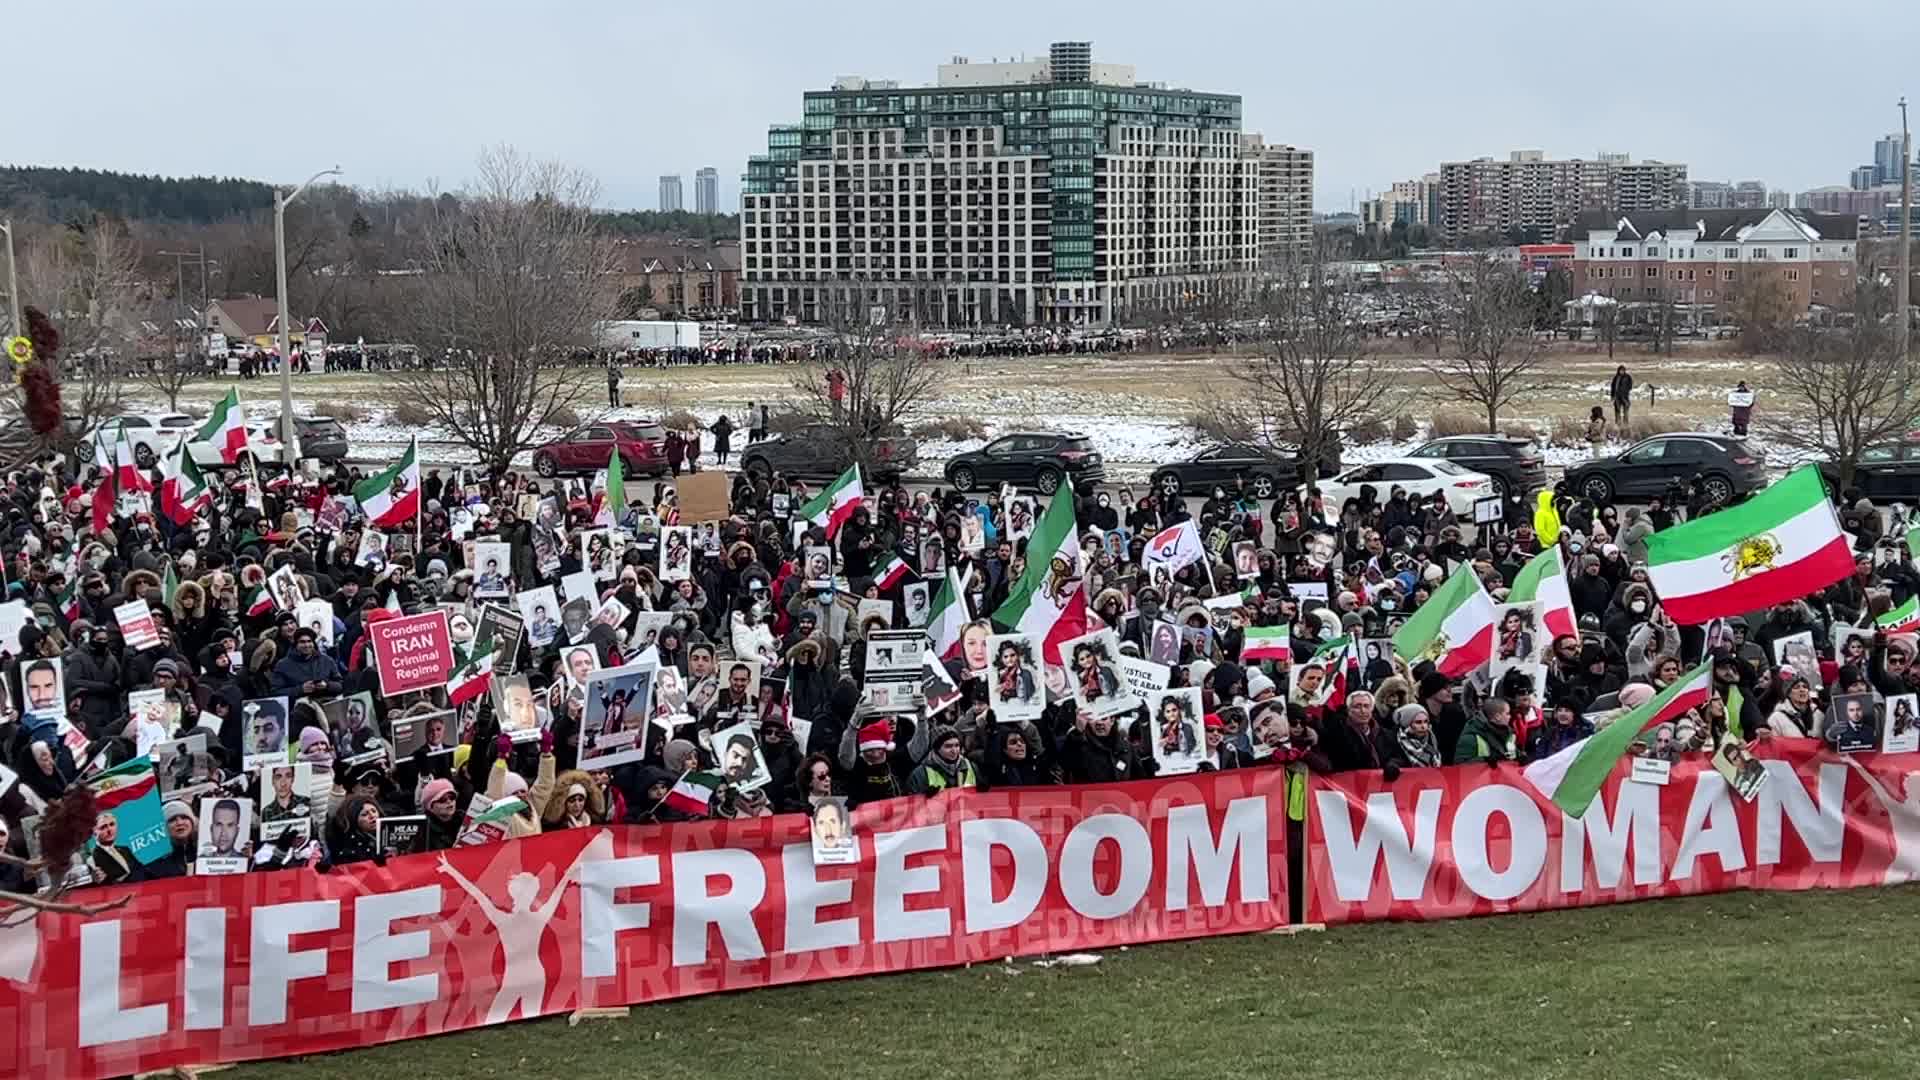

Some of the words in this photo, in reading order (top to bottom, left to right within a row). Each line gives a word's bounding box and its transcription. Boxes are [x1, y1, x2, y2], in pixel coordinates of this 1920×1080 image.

[382, 621, 437, 638] Condemn
[391, 634, 434, 654] IRAN
[392, 649, 439, 668] Criminal
[396, 664, 439, 680] Regime
[130, 827, 166, 853] IRAN
[1314, 760, 1849, 902] WOMAN
[78, 884, 441, 1048] LIFE
[581, 795, 1270, 978] FREEDOM
